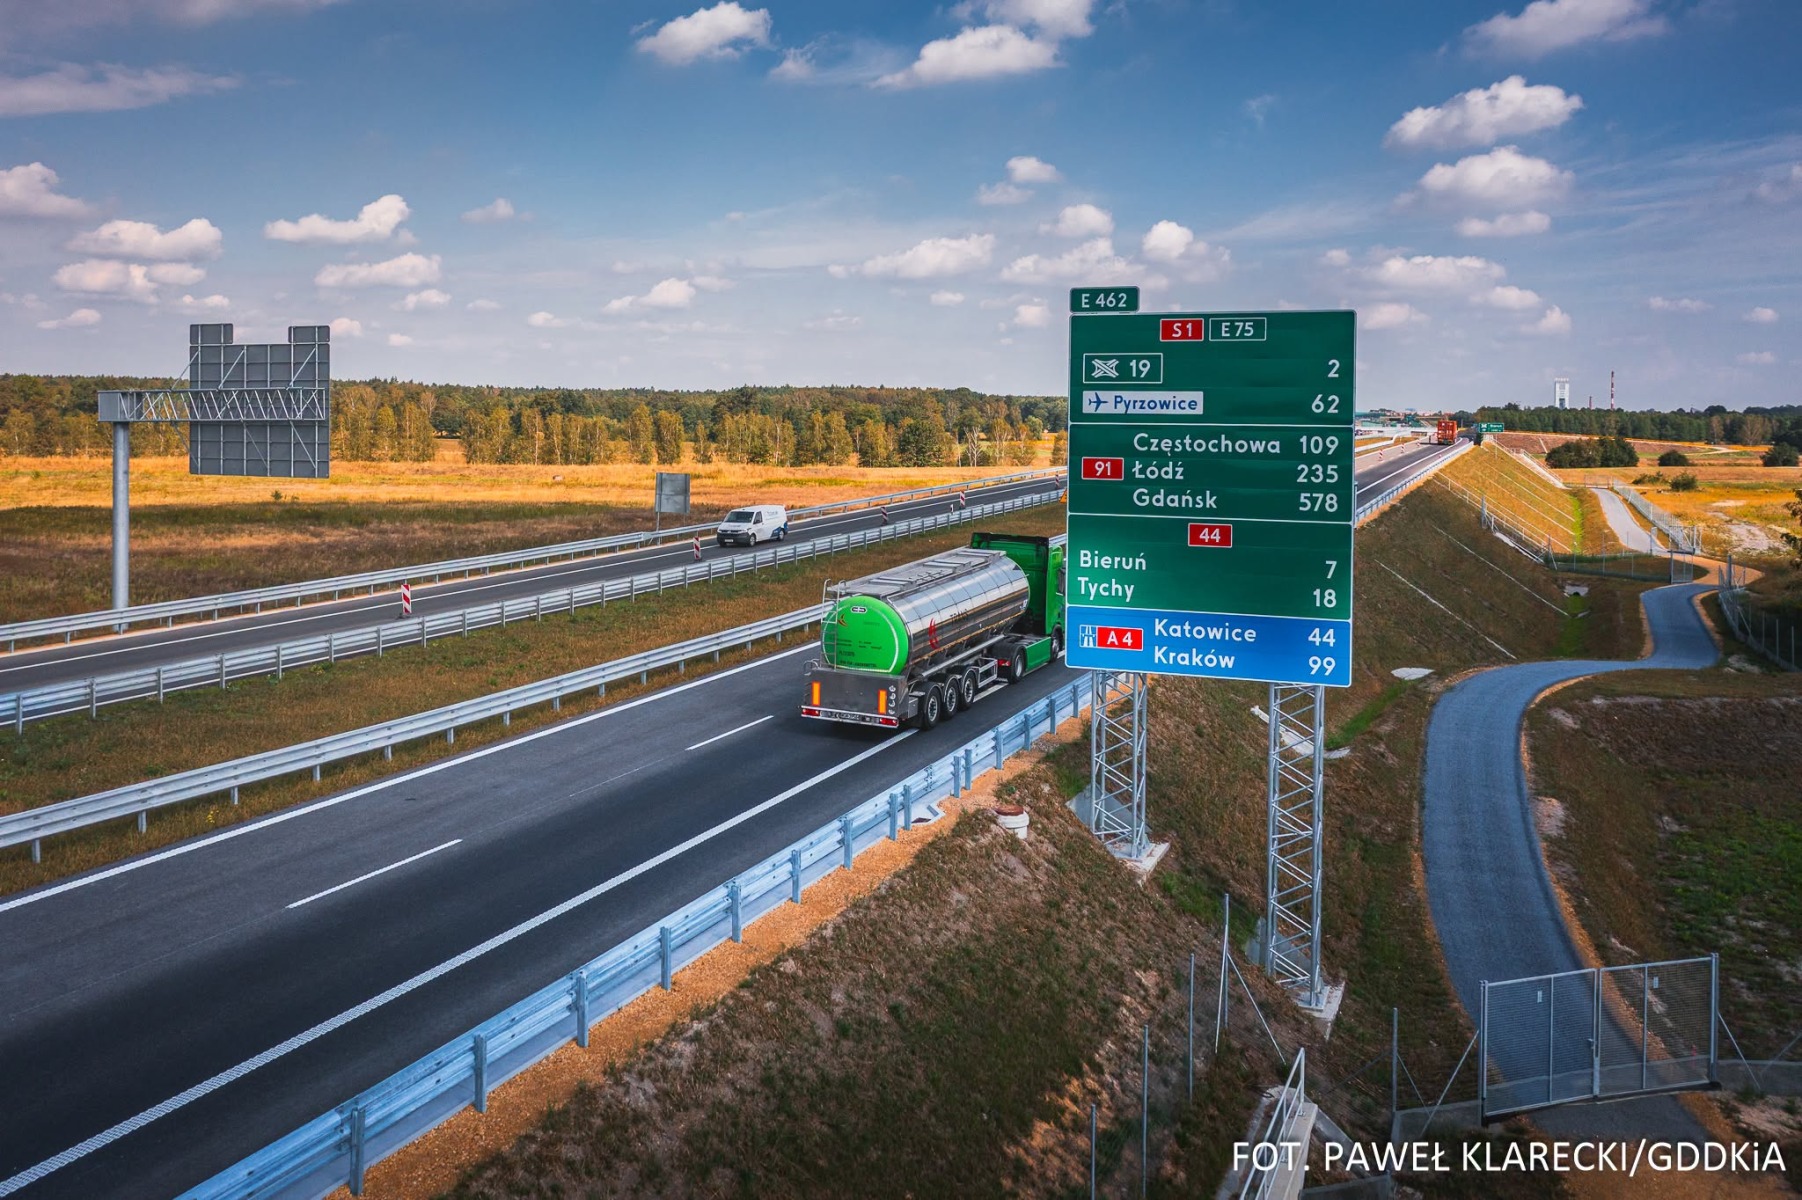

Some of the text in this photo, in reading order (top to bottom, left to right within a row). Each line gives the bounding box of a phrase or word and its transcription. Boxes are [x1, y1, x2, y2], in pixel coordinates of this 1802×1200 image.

[1129, 359, 1151, 378] 19
[1327, 359, 1340, 378] 2
[1113, 394, 1339, 414] Pyrzowice 62
[1133, 433, 1339, 456] Częstochowa 109
[1094, 461, 1112, 476] 91
[1131, 461, 1339, 483] Łódź 235
[1132, 487, 1338, 513] Gdańsk 578
[1199, 527, 1221, 543] 44
[1079, 549, 1337, 579] Bieruń 7
[1077, 577, 1337, 608] Tychy 18
[1154, 618, 1336, 648] Katowice 44
[1153, 645, 1336, 676] Kraków 99
